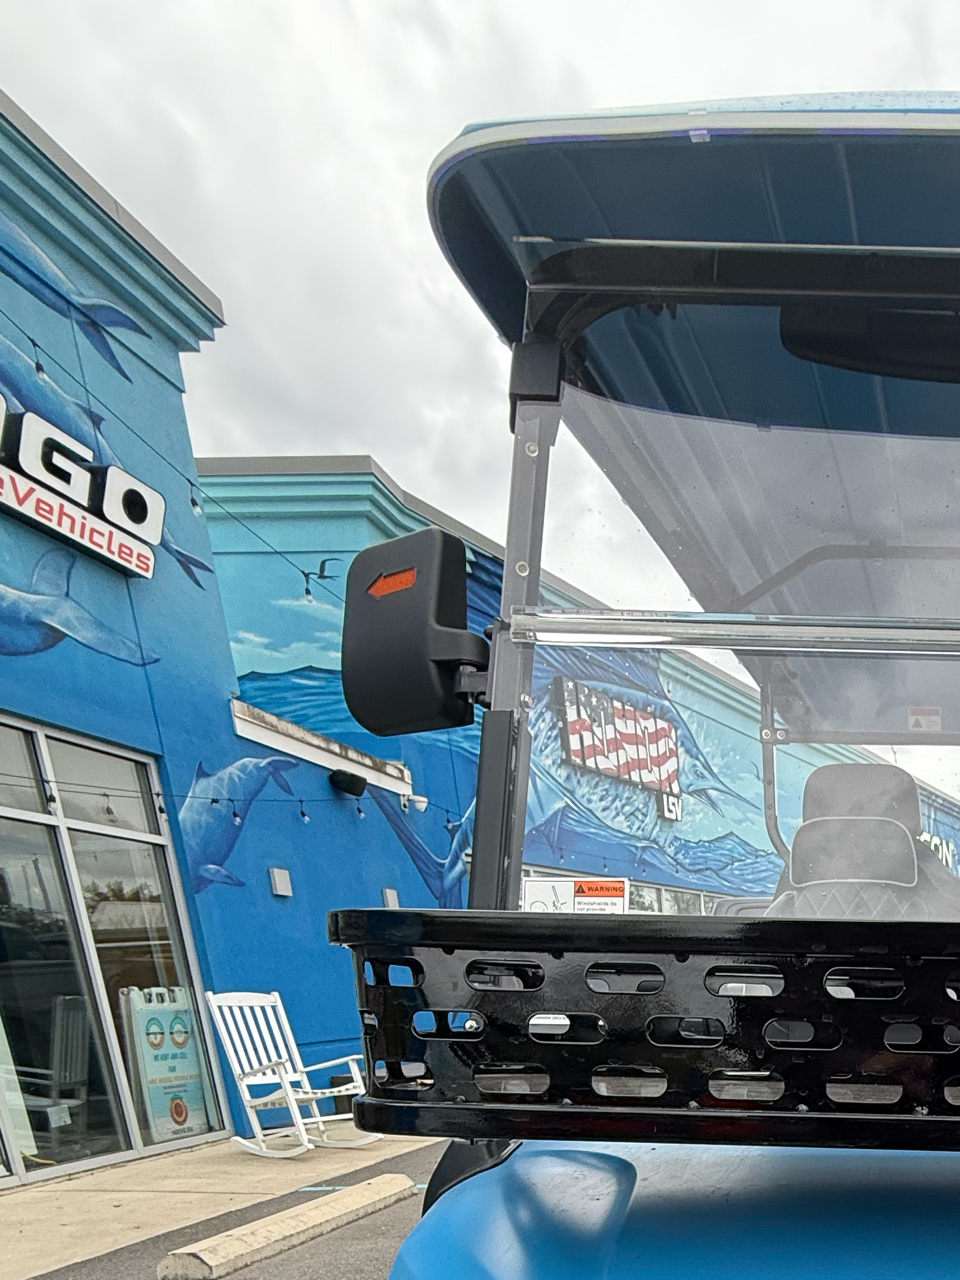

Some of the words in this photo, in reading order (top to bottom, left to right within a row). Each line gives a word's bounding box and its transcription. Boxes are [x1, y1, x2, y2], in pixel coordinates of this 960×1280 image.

[0, 393, 166, 546] GO
[0, 474, 151, 573] Vehicles
[662, 793, 683, 822] LSV
